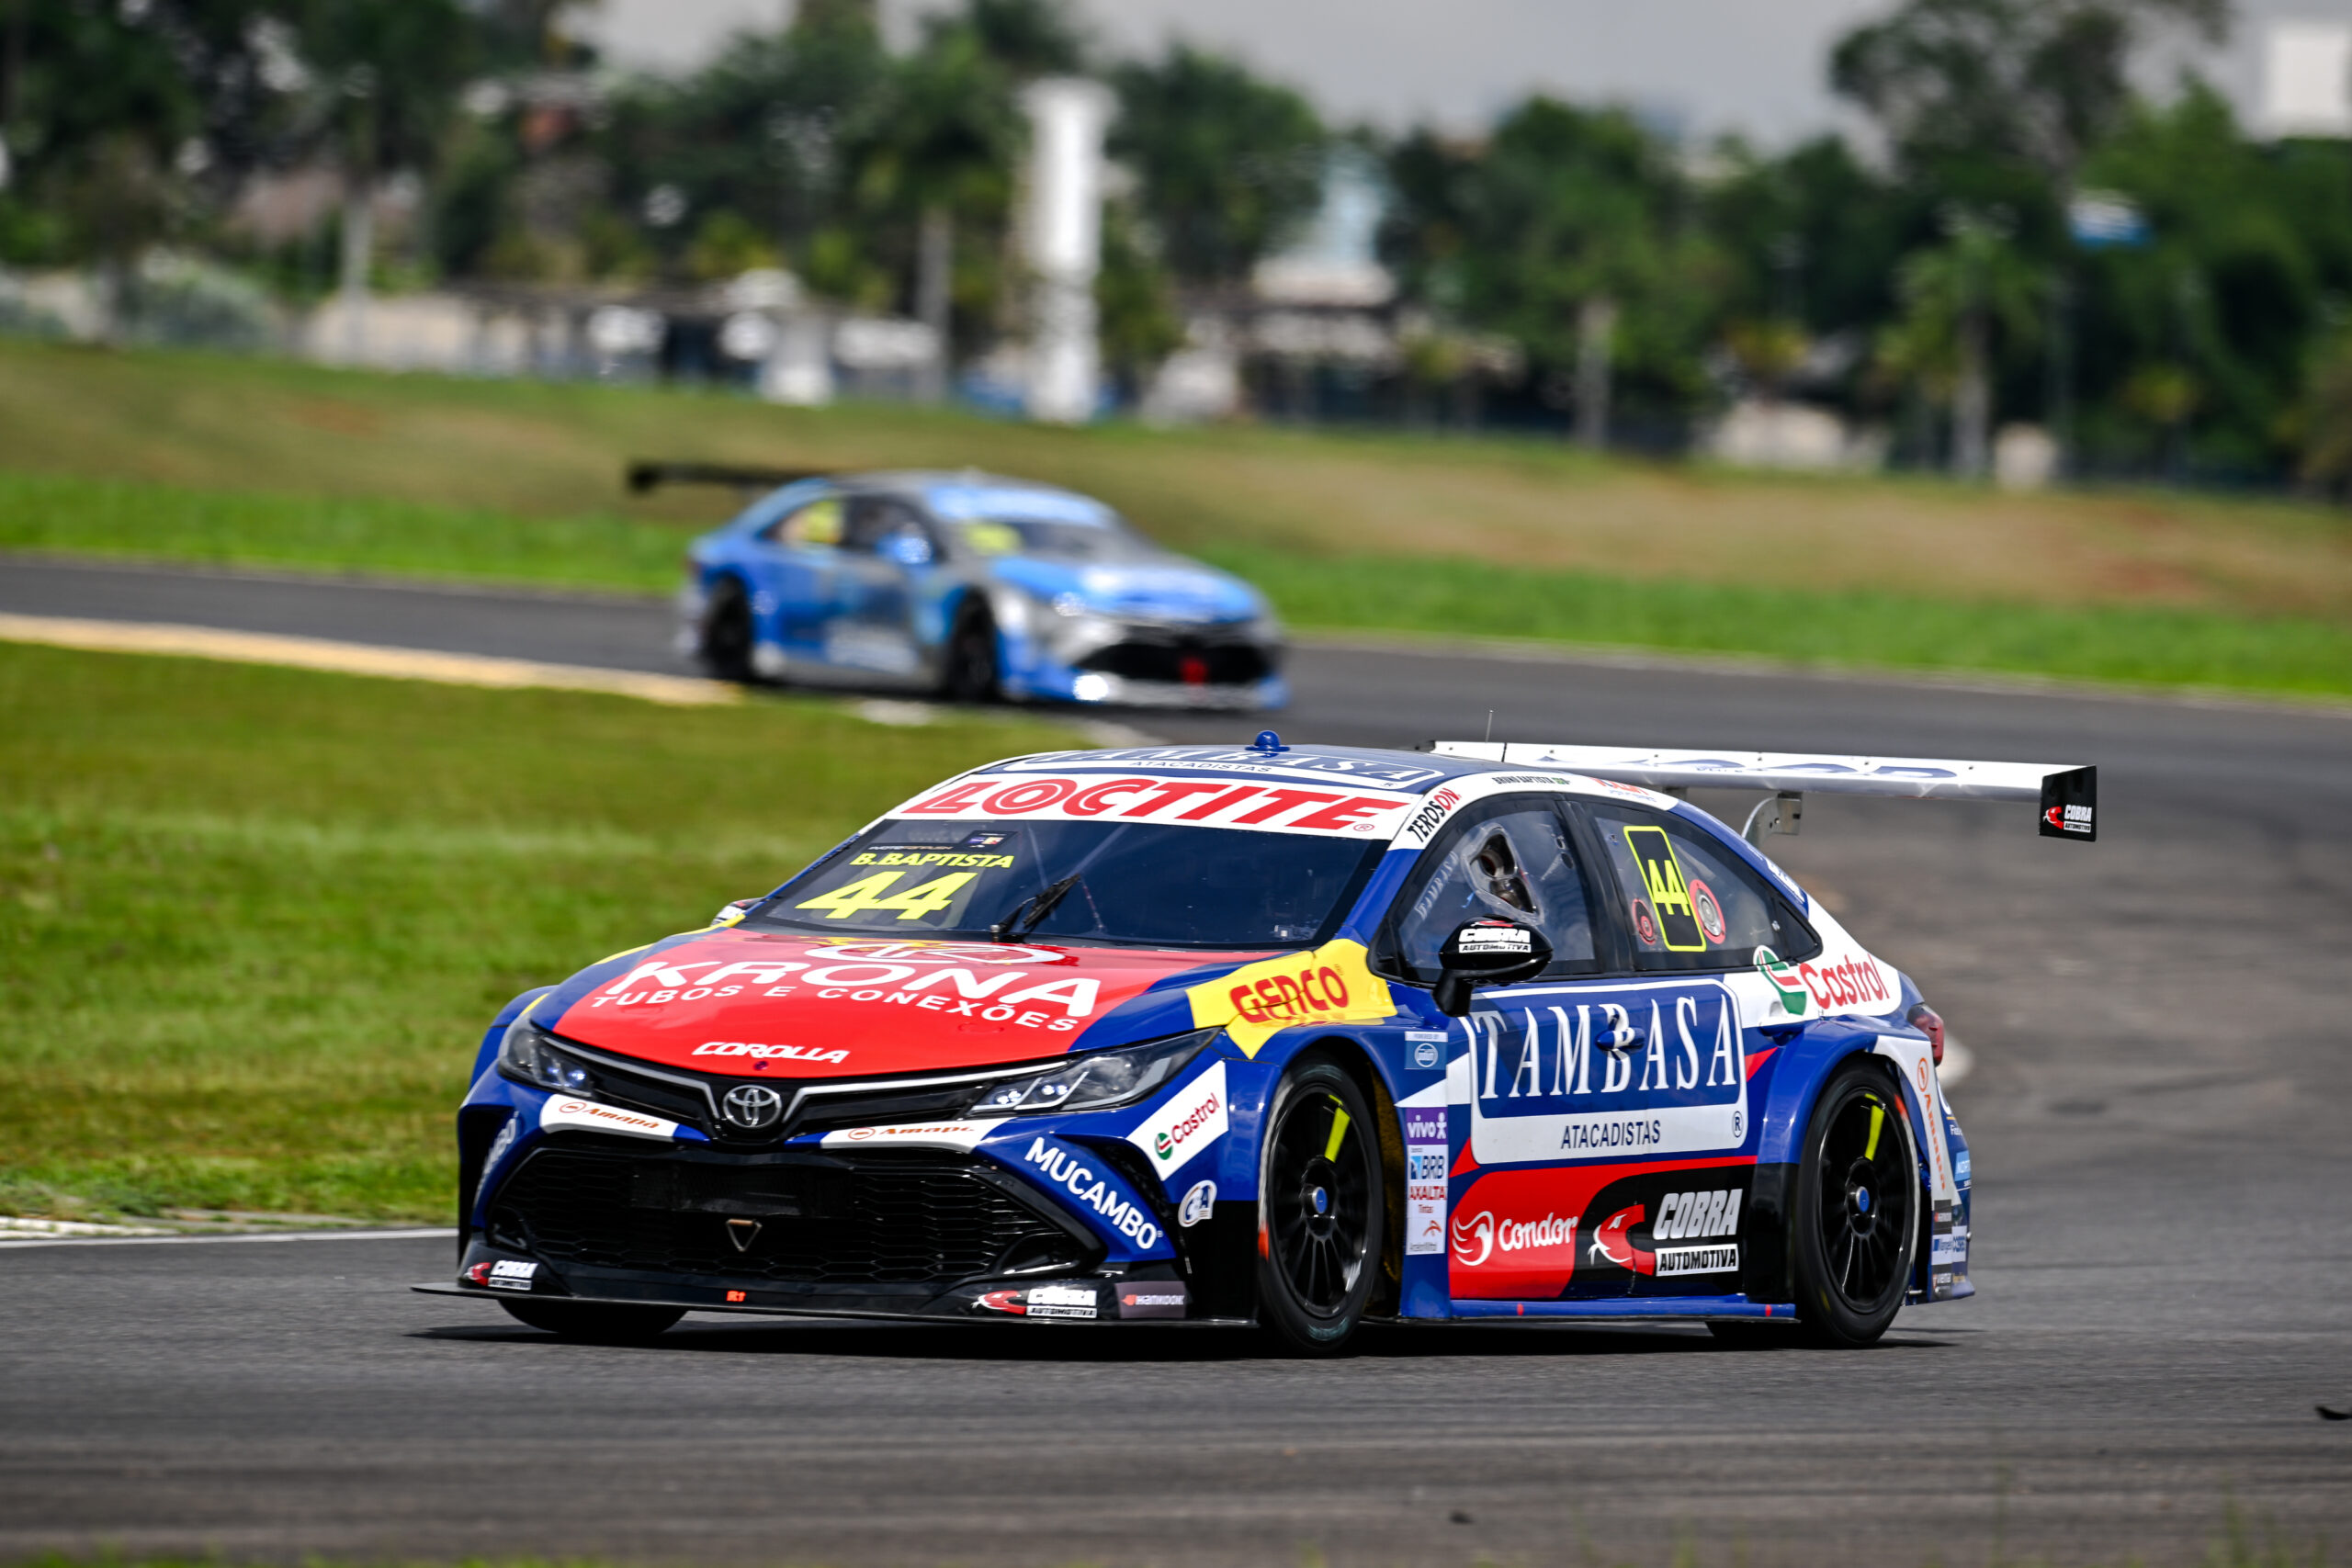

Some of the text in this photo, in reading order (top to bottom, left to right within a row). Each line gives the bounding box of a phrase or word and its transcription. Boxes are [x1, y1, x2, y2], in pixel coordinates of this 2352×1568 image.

[1133, 761, 1273, 773] ATACADISTAS
[901, 778, 1411, 832] LOCTITE
[1407, 787, 1461, 843] TEROSON
[2064, 804, 2093, 822] COBRA
[849, 852, 1015, 869] B.BAPTISTA
[795, 871, 978, 920] 44
[1647, 859, 1691, 917] 44
[1458, 928, 1531, 943] COBRA
[606, 960, 1104, 1018] KRONA
[1799, 953, 1891, 1010] Castrol
[592, 984, 1080, 1032] TUBOS E CONEXÕES
[692, 1041, 851, 1065] COROLLA
[1472, 994, 1738, 1100] TAMBASA
[1170, 1093, 1221, 1145] Castrol
[1407, 1114, 1437, 1139] vivo
[1561, 1120, 1661, 1150] ATACADISTAS
[1421, 1155, 1445, 1180] BRB
[1024, 1136, 1159, 1250] MUCAMBO
[1408, 1185, 1448, 1201] AXALTA
[1654, 1188, 1744, 1241] COBRA
[1498, 1213, 1579, 1252] Condor
[1658, 1247, 1737, 1274] AUTOMOTIVA
